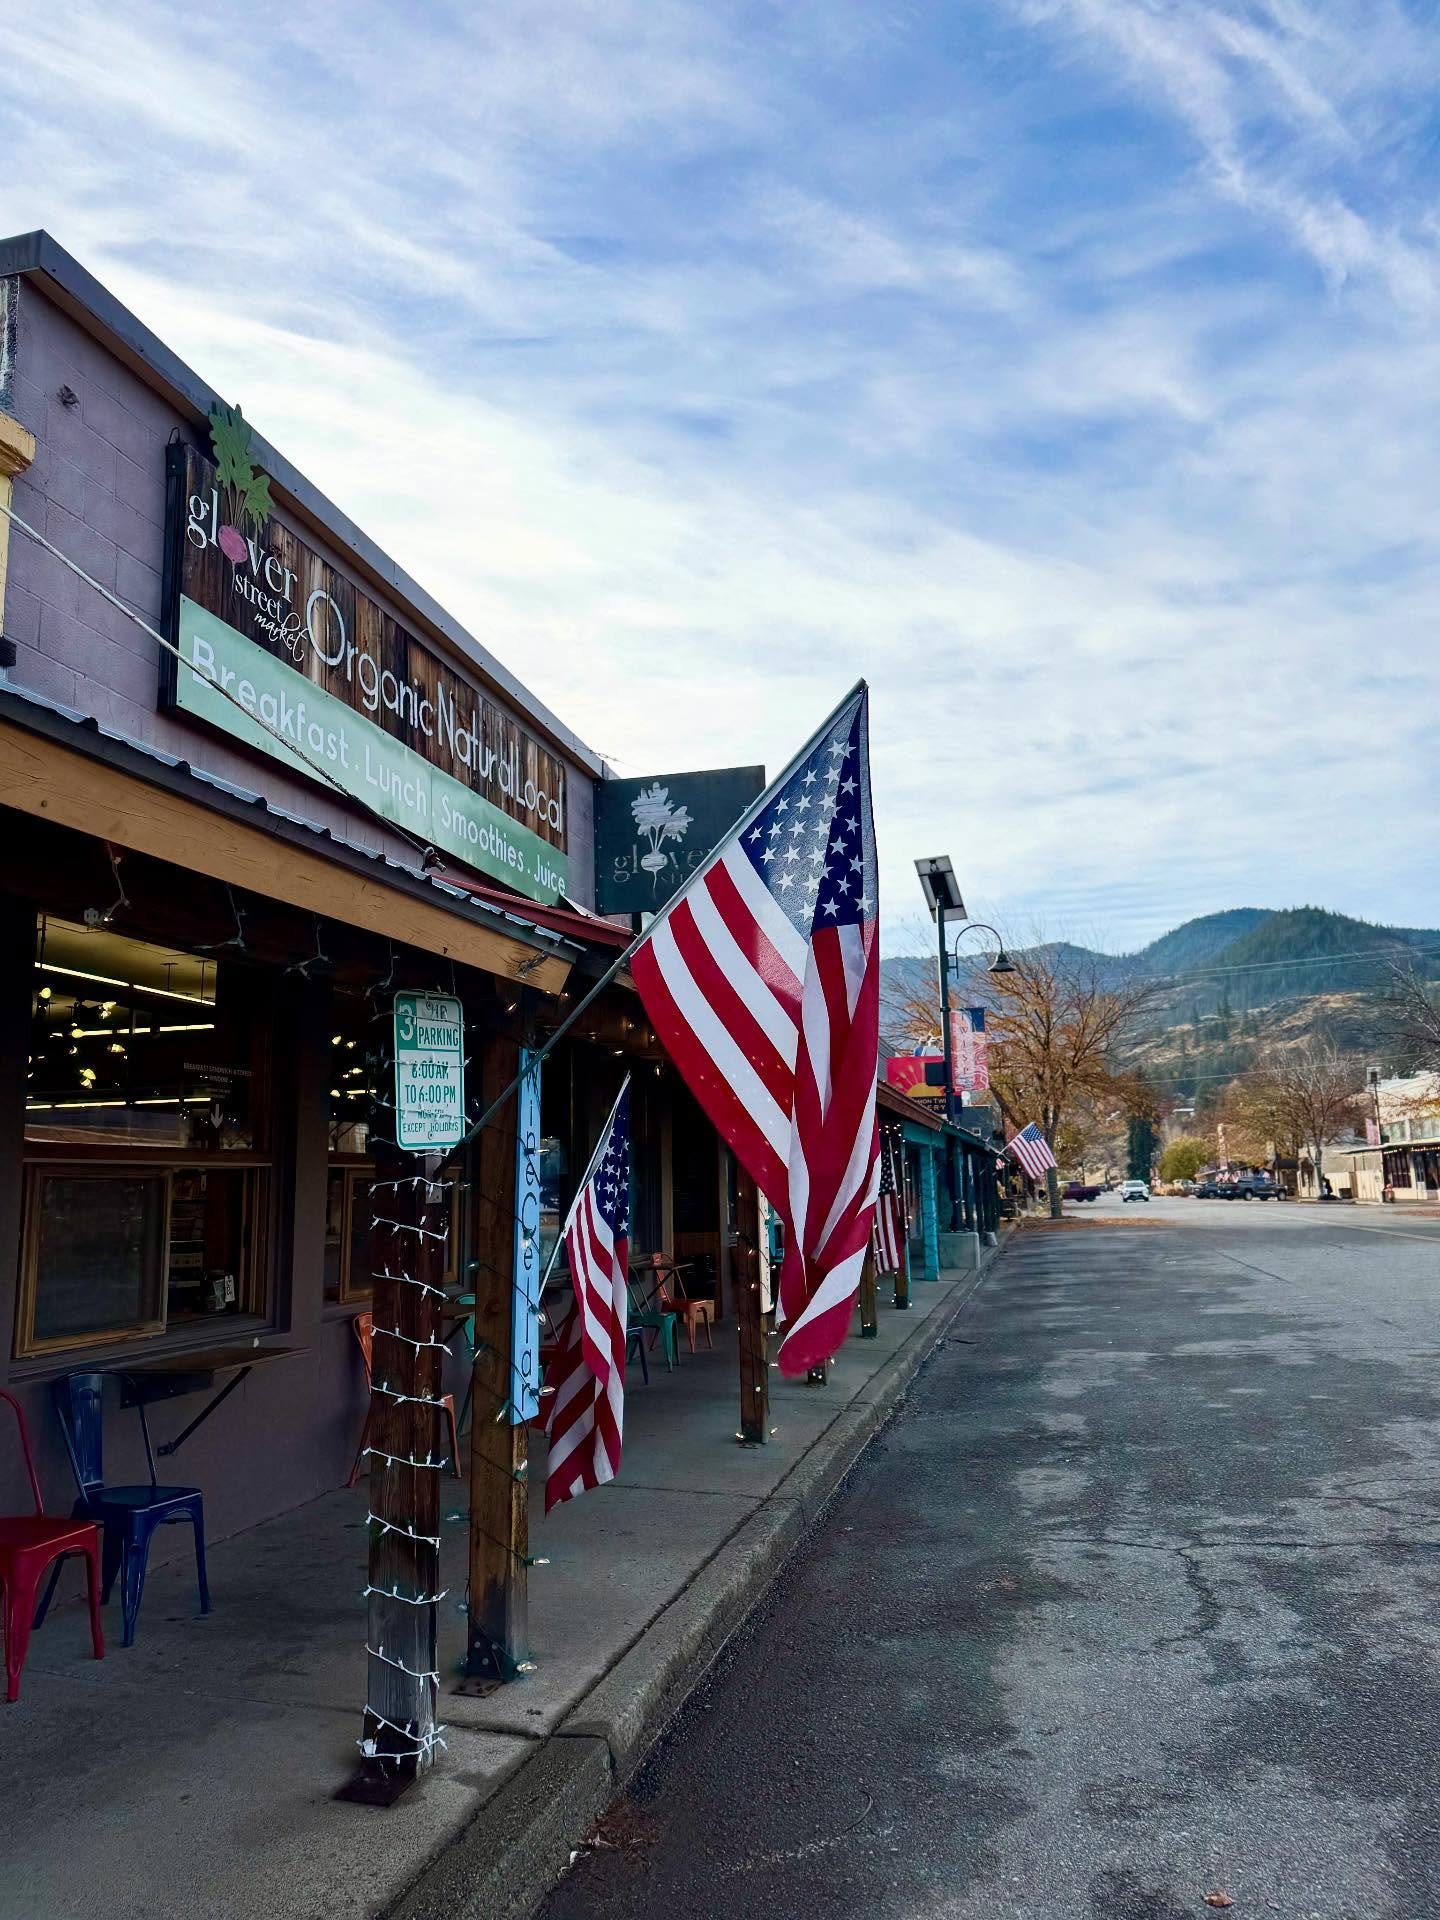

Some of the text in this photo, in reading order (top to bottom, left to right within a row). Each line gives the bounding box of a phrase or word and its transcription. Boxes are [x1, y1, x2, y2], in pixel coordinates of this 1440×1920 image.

[235, 573, 283, 623] street
[254, 612, 308, 662] market
[306, 589, 563, 833] Organic Natural Local
[192, 635, 566, 896] Breakfast Lunch Smoothies Juice
[400, 1004, 414, 1041] 3
[418, 1026, 459, 1047] PARKING
[404, 1084, 456, 1104] TO 6:00 PM
[520, 1191, 538, 1413] Cellar
